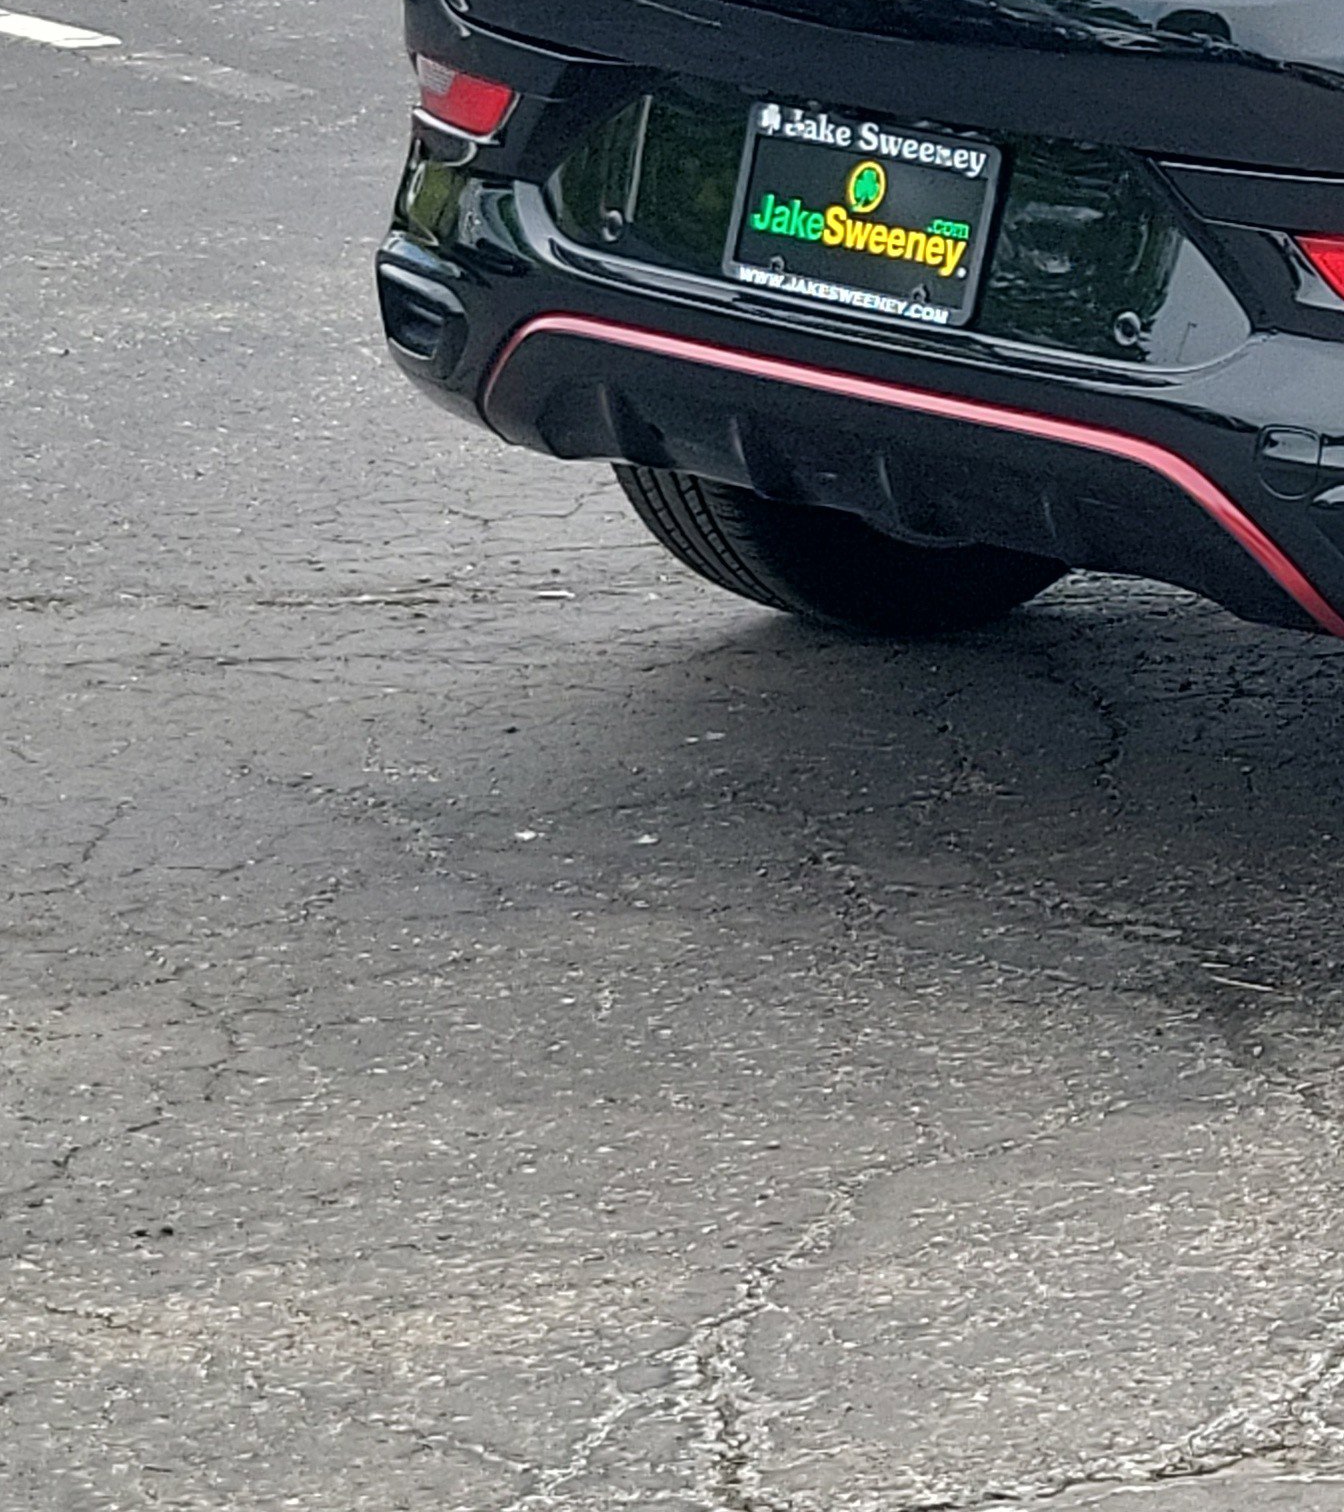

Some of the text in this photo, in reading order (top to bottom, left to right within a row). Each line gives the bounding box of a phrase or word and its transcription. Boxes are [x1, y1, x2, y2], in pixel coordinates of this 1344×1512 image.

[783, 108, 987, 178] Jake Sweeney
[739, 267, 950, 325] WWW.JAKESWEENEY.COM
